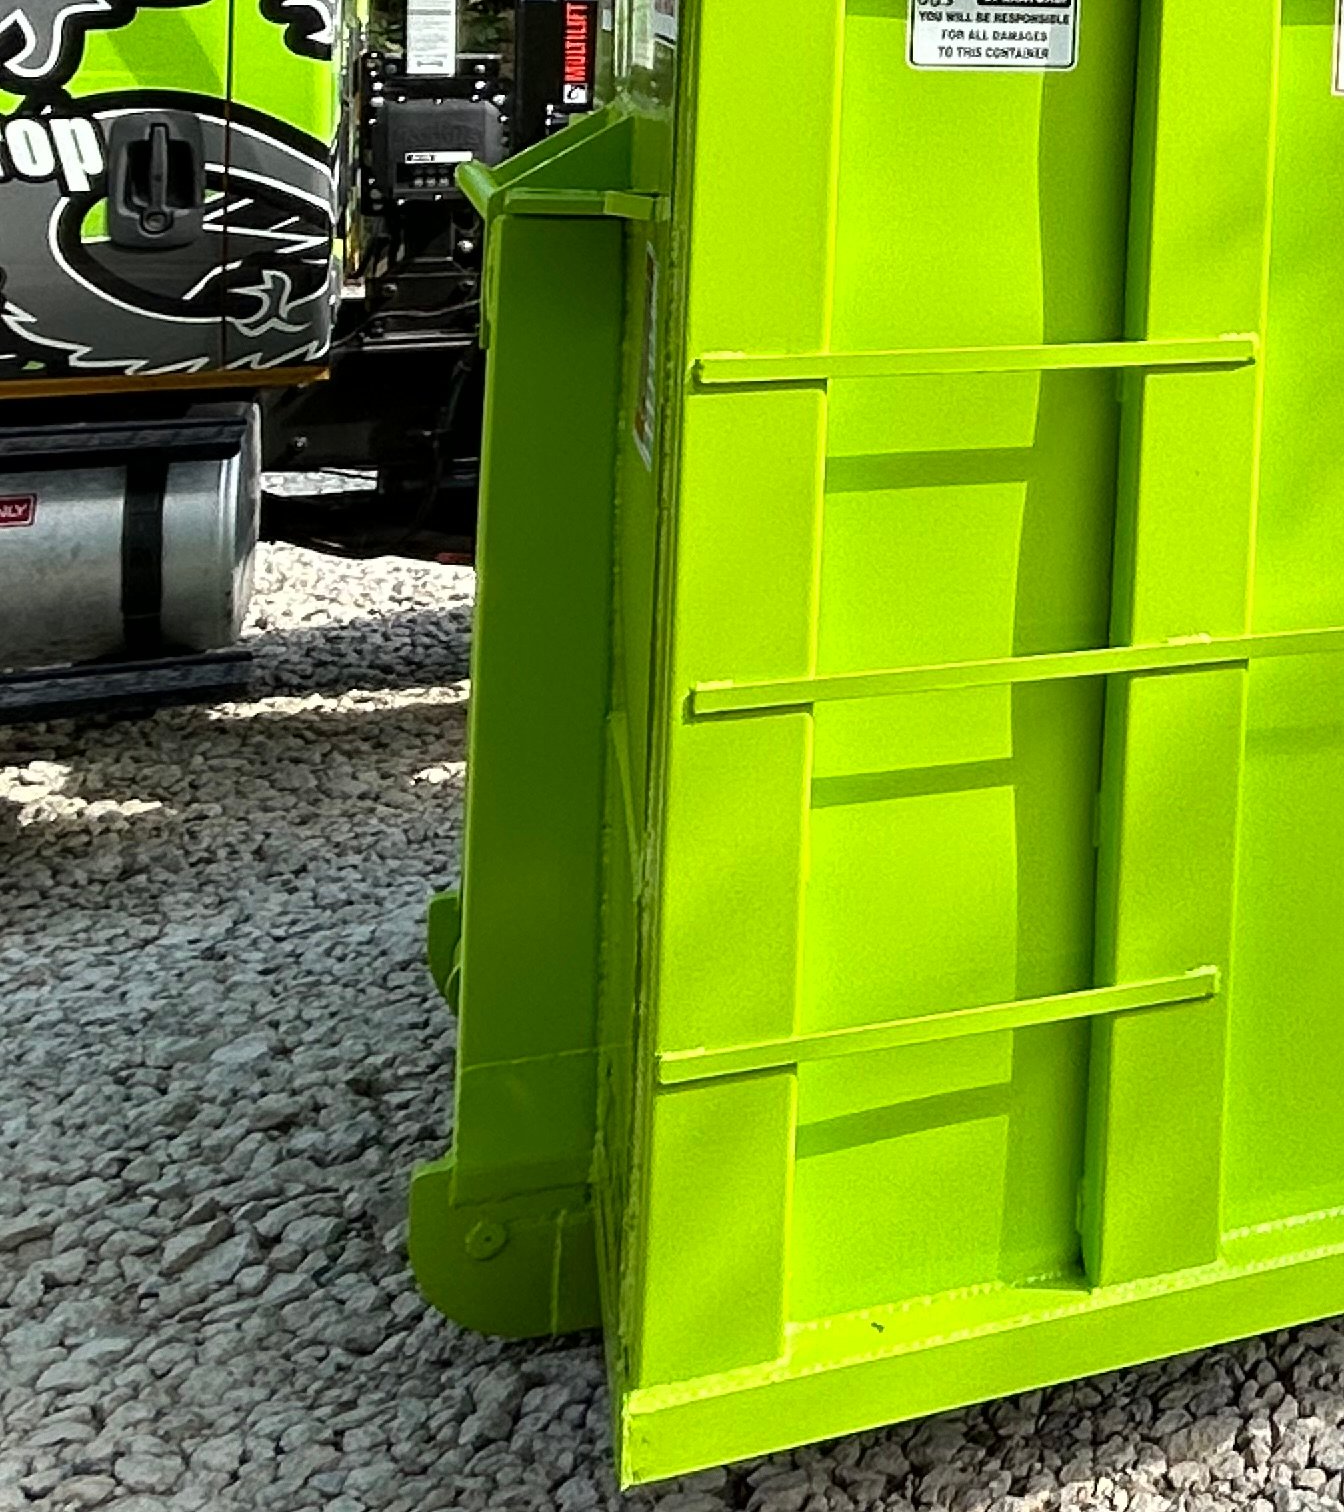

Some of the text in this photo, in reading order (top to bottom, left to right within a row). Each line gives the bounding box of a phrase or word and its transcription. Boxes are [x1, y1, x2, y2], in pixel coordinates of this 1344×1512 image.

[919, 11, 1069, 25] YOU WILL BE RESPONSIBLE
[565, 3, 588, 82] MULTILIFT
[941, 29, 1048, 42] FOR ALL DAMAGES
[938, 46, 1049, 59] TO THIS CONTAINER
[0, 117, 103, 192] op
